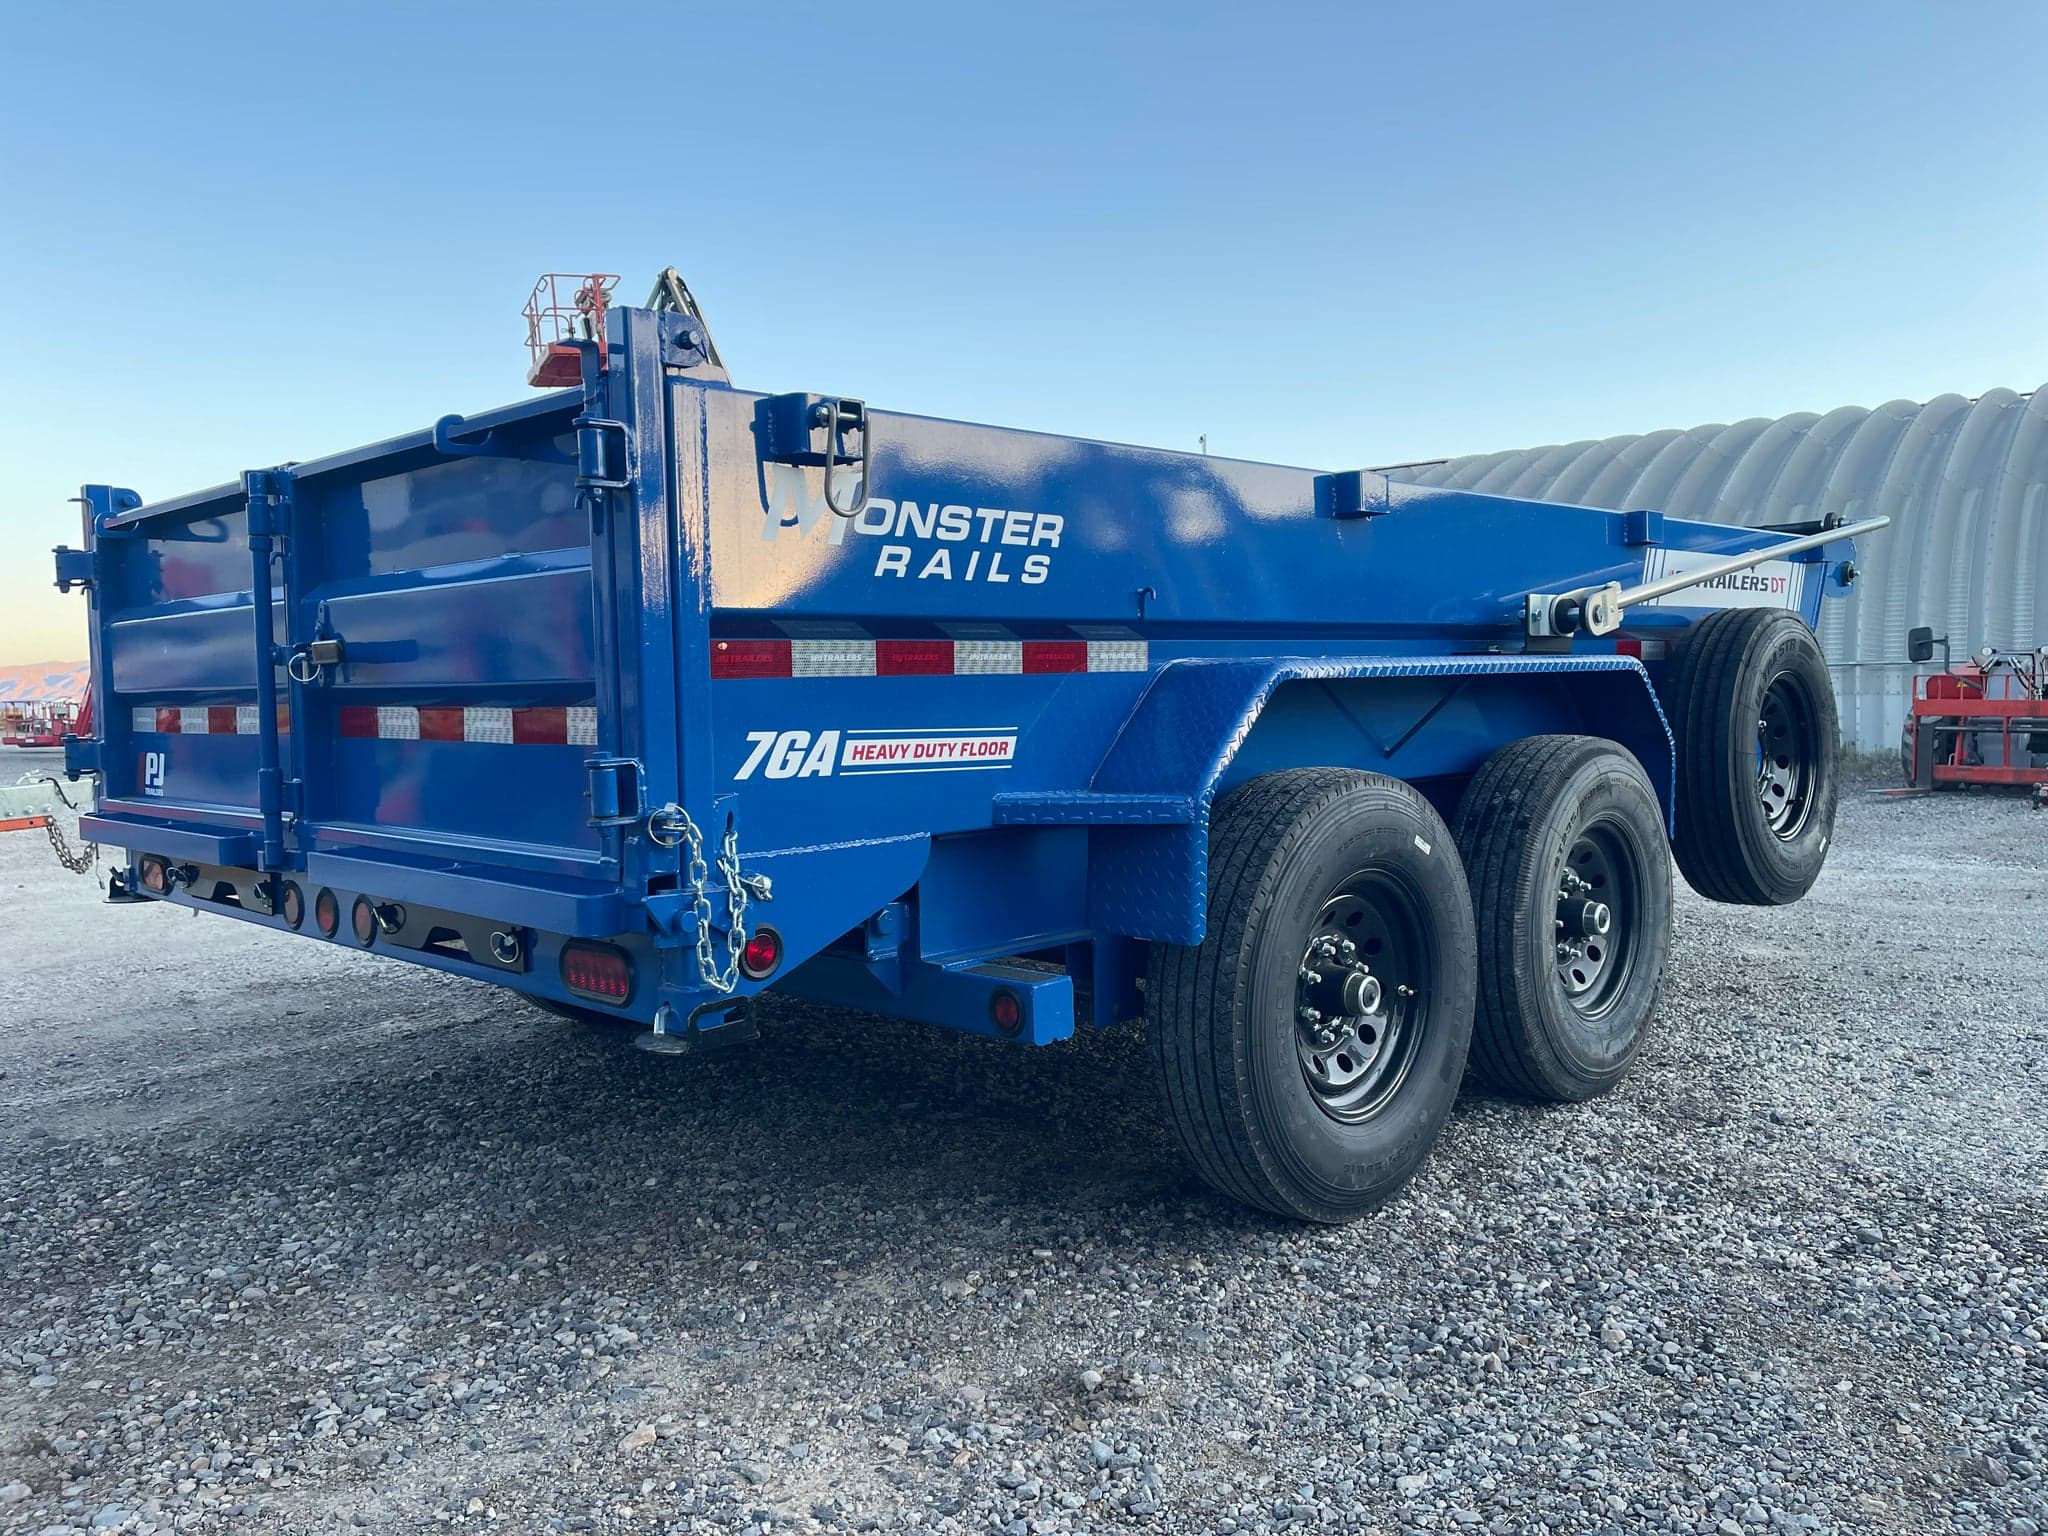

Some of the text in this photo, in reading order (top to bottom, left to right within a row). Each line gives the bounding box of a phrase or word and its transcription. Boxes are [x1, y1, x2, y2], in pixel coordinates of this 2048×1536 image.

[760, 464, 1064, 549] MONSTER
[874, 545, 1051, 584] RAILS
[1695, 575, 1786, 593] RAILERS DT
[145, 752, 165, 786] PJ
[733, 729, 1009, 781] 7GA HEAVY DUTY FLOOR
